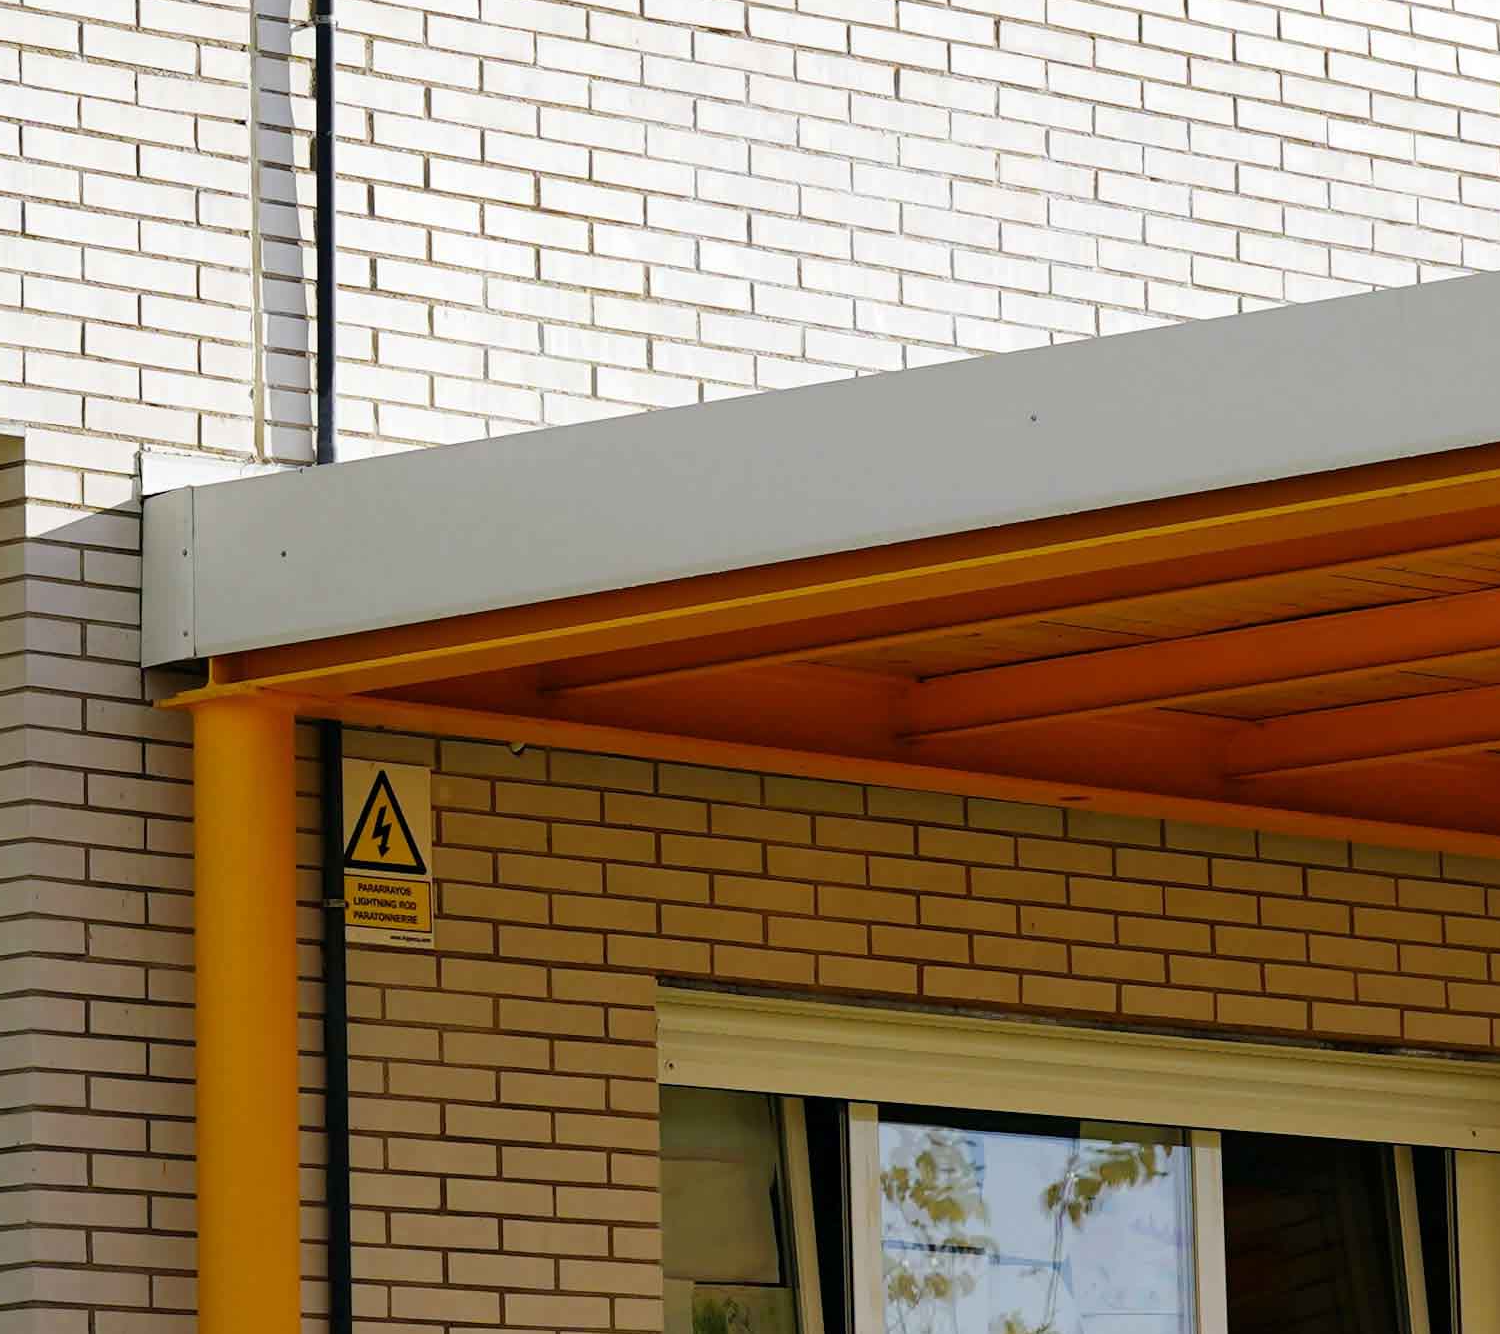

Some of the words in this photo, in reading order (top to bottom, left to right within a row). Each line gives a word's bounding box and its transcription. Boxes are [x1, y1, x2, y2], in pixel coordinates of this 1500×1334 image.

[358, 883, 412, 896] PARARRAYOS
[353, 898, 397, 909] LIGHTNING
[399, 901, 417, 911] ROD
[353, 910, 417, 924] PARATONNERRE
